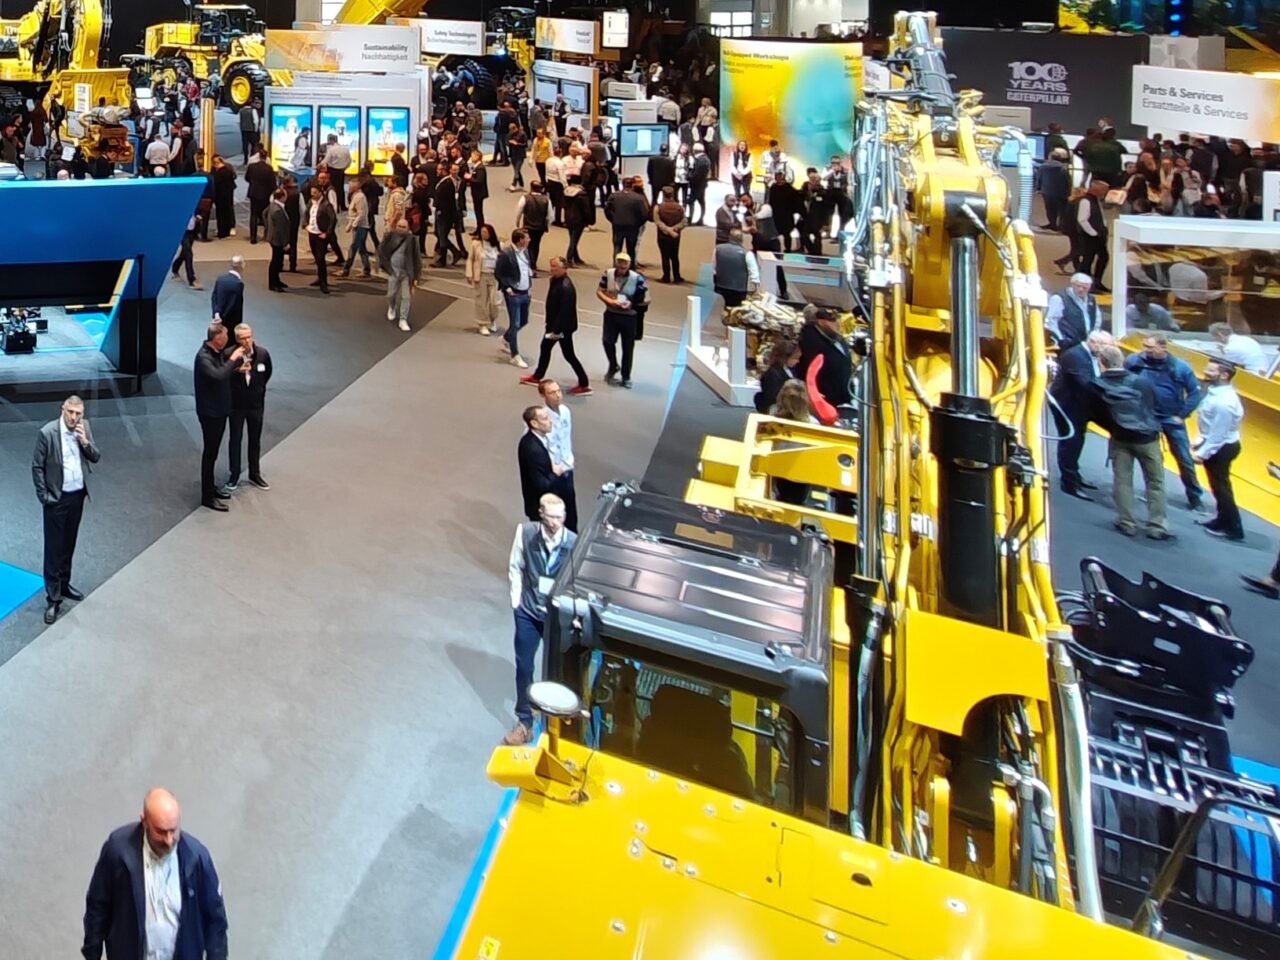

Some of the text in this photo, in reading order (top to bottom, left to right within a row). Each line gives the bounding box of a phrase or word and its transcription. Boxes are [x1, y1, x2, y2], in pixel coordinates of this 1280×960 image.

[363, 43, 408, 53] Sustainability
[361, 52, 408, 61] Nachhaltigkeit
[1008, 61, 1068, 82] 100
[1009, 80, 1067, 92] YEARS
[1142, 83, 1224, 102] Parts & Services
[1007, 91, 1070, 105] CATERPILLAR
[1142, 98, 1248, 120] Ersatzteile & Services
